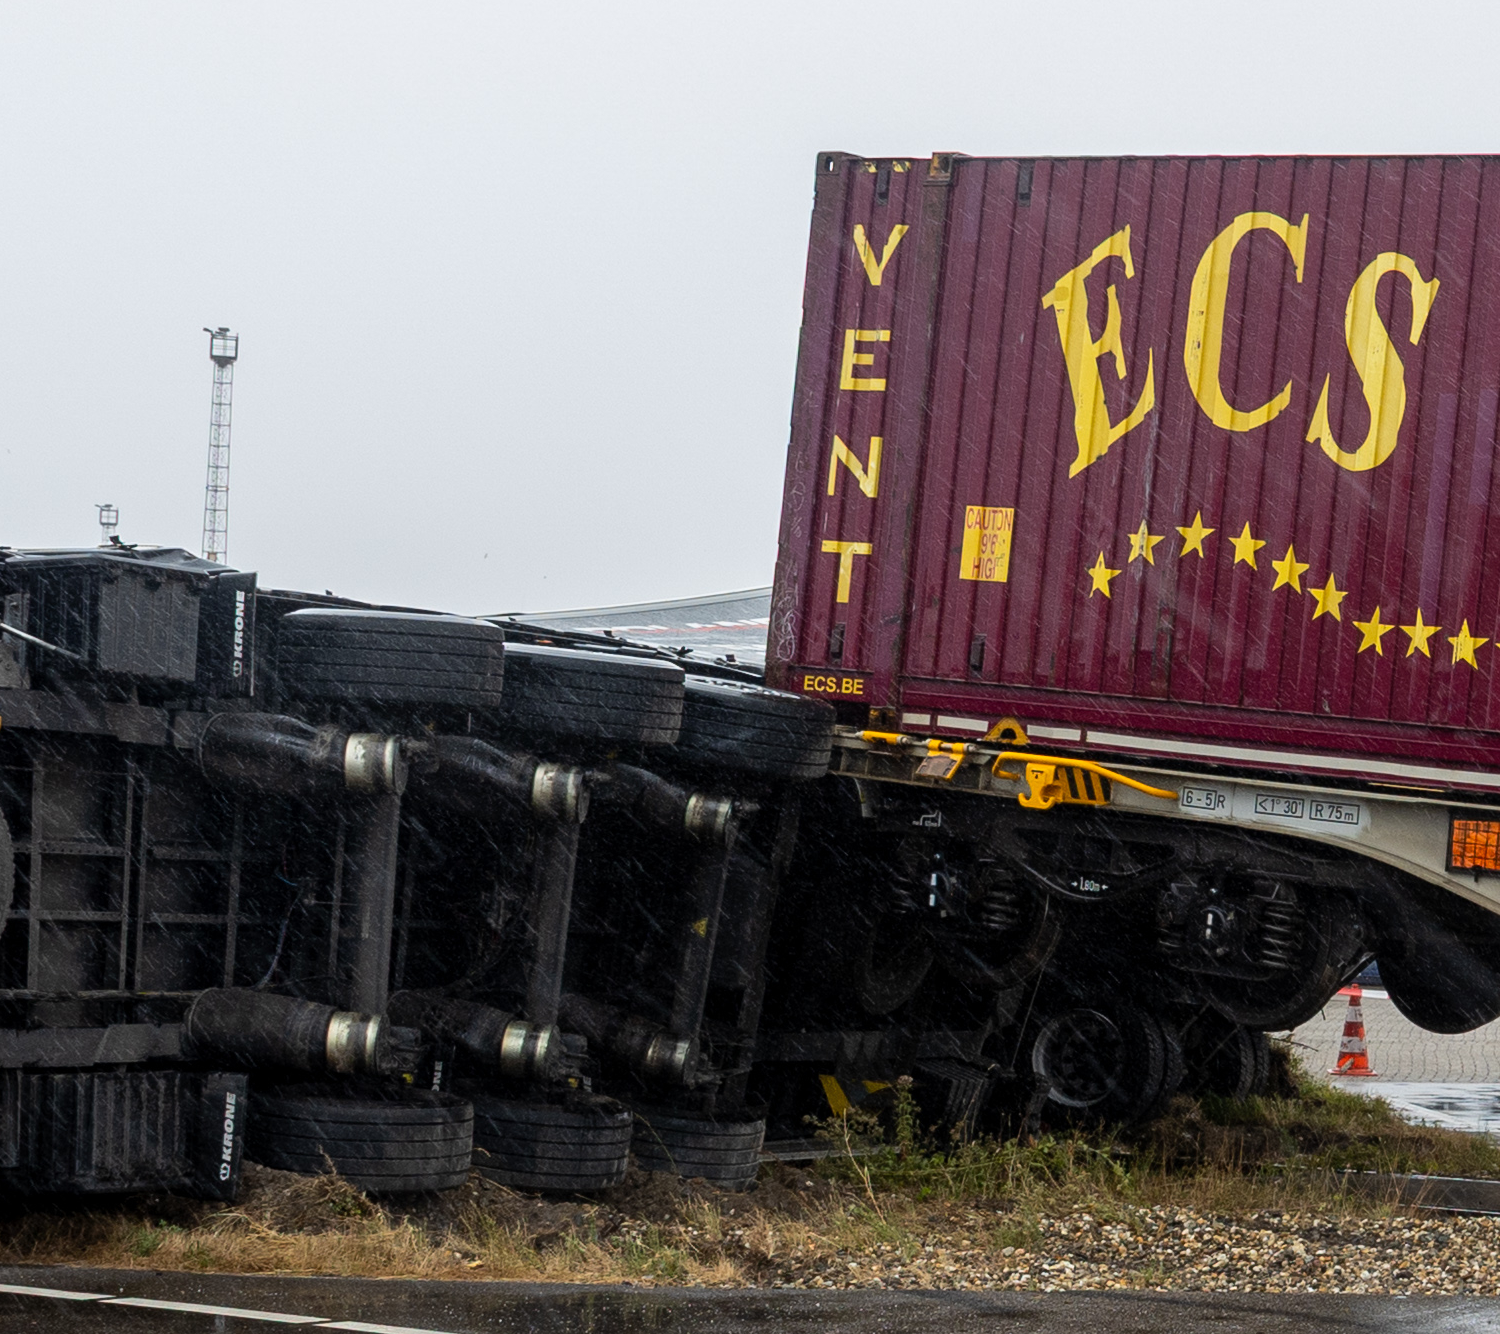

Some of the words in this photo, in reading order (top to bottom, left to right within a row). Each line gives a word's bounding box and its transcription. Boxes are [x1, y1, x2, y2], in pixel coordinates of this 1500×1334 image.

[1041, 211, 1440, 479] ECS
[821, 224, 909, 603] VENT
[234, 590, 245, 658] KRONE
[803, 675, 864, 695] ECS.BE
[222, 1092, 236, 1161] KRONE
